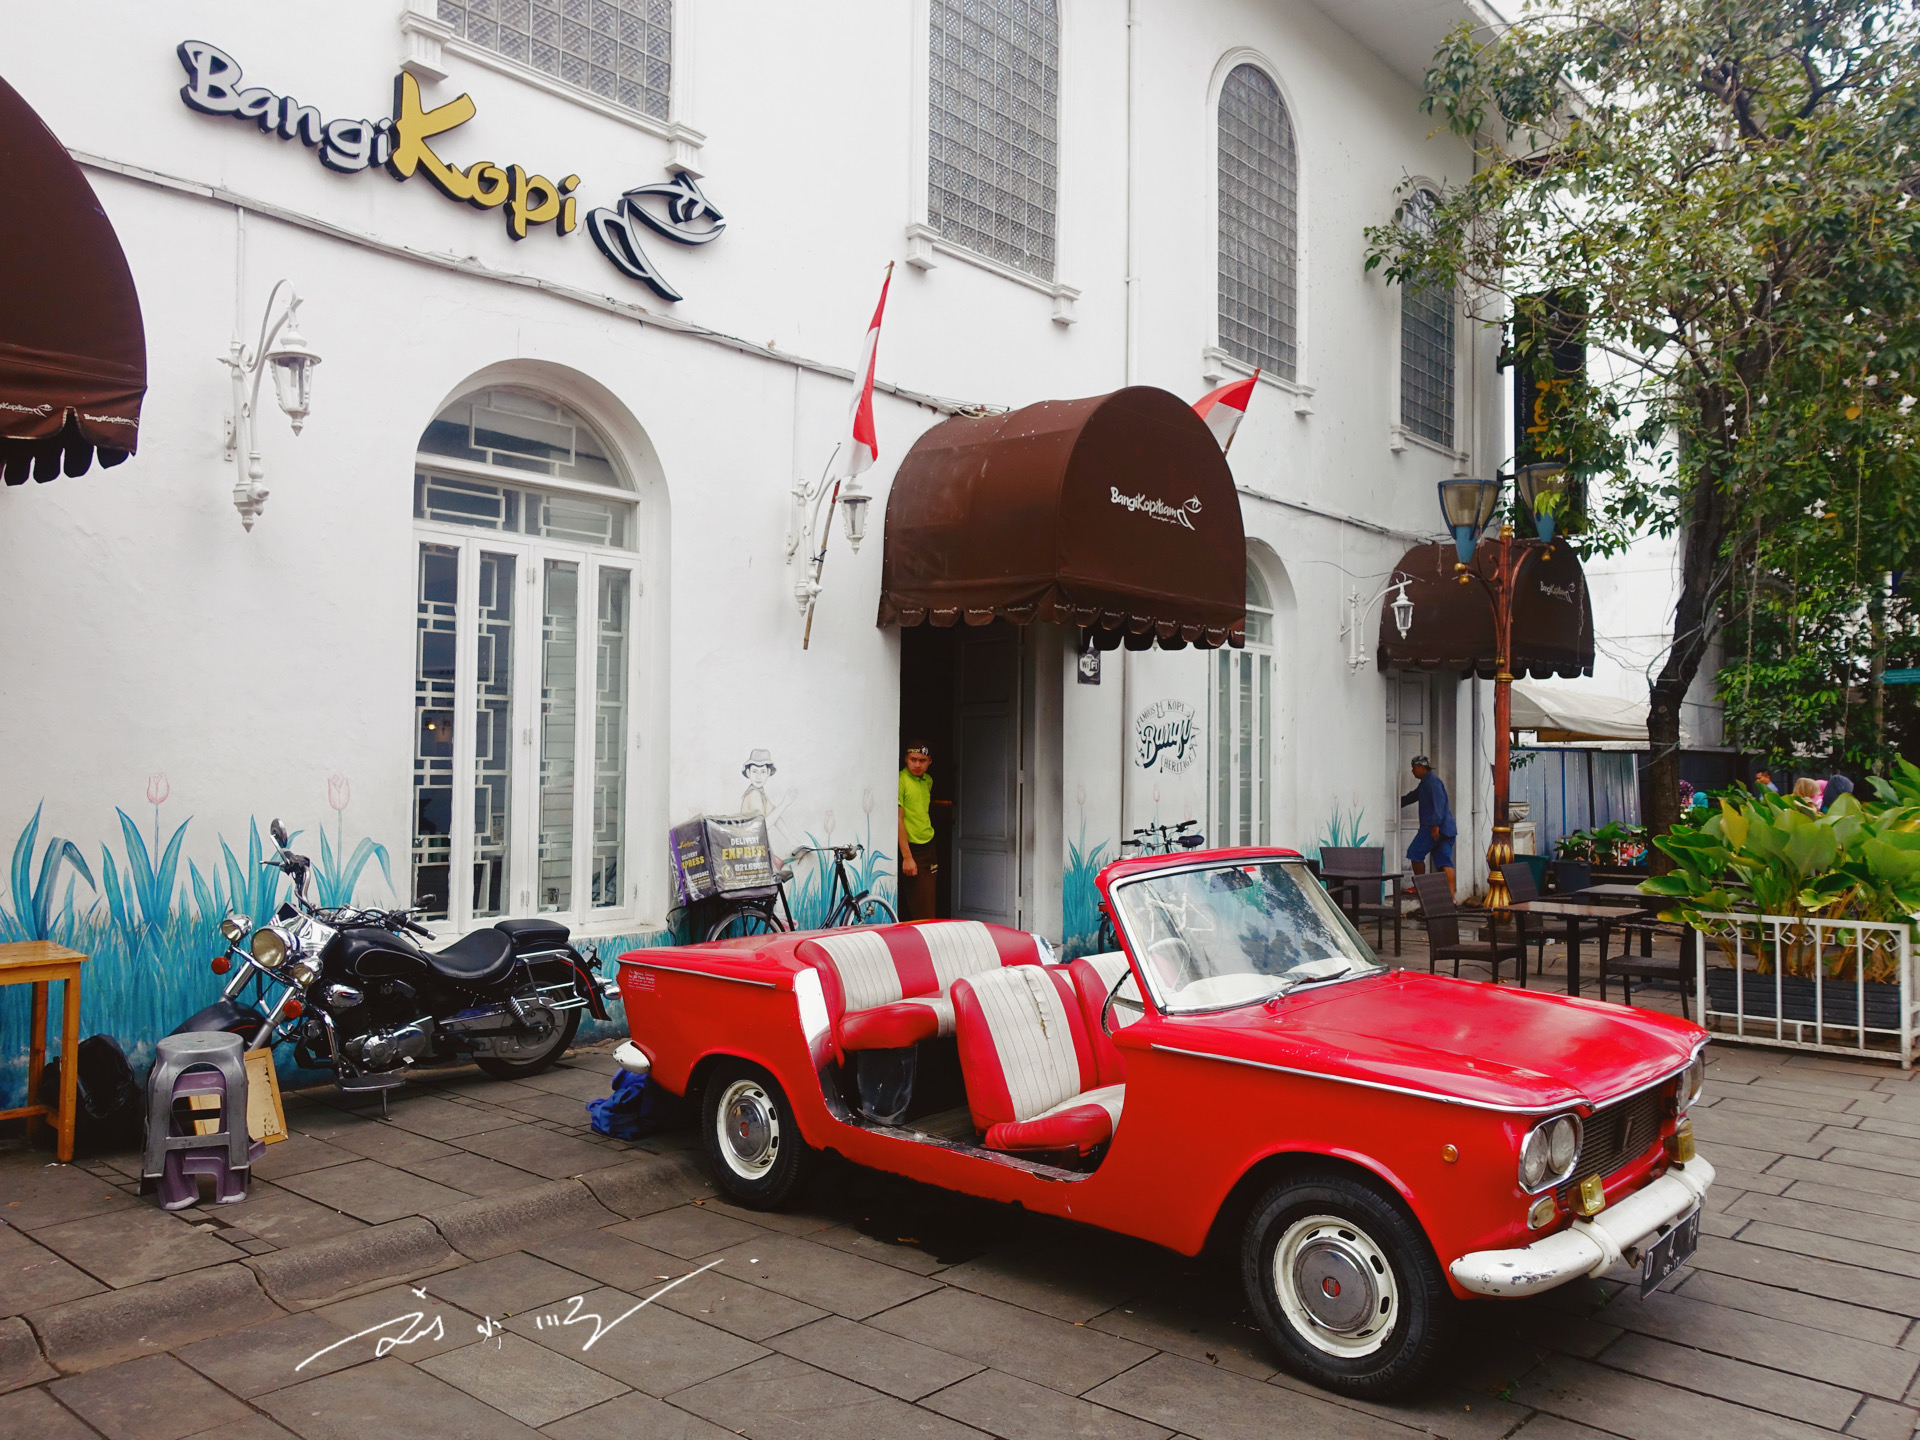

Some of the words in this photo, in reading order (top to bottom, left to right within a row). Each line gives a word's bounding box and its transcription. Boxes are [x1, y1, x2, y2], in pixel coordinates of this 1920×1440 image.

[1137, 705, 1156, 727] FAMOUS
[1167, 700, 1185, 712] KOPI
[730, 836, 760, 846] DELIVERY
[721, 845, 767, 860] EXPRESS
